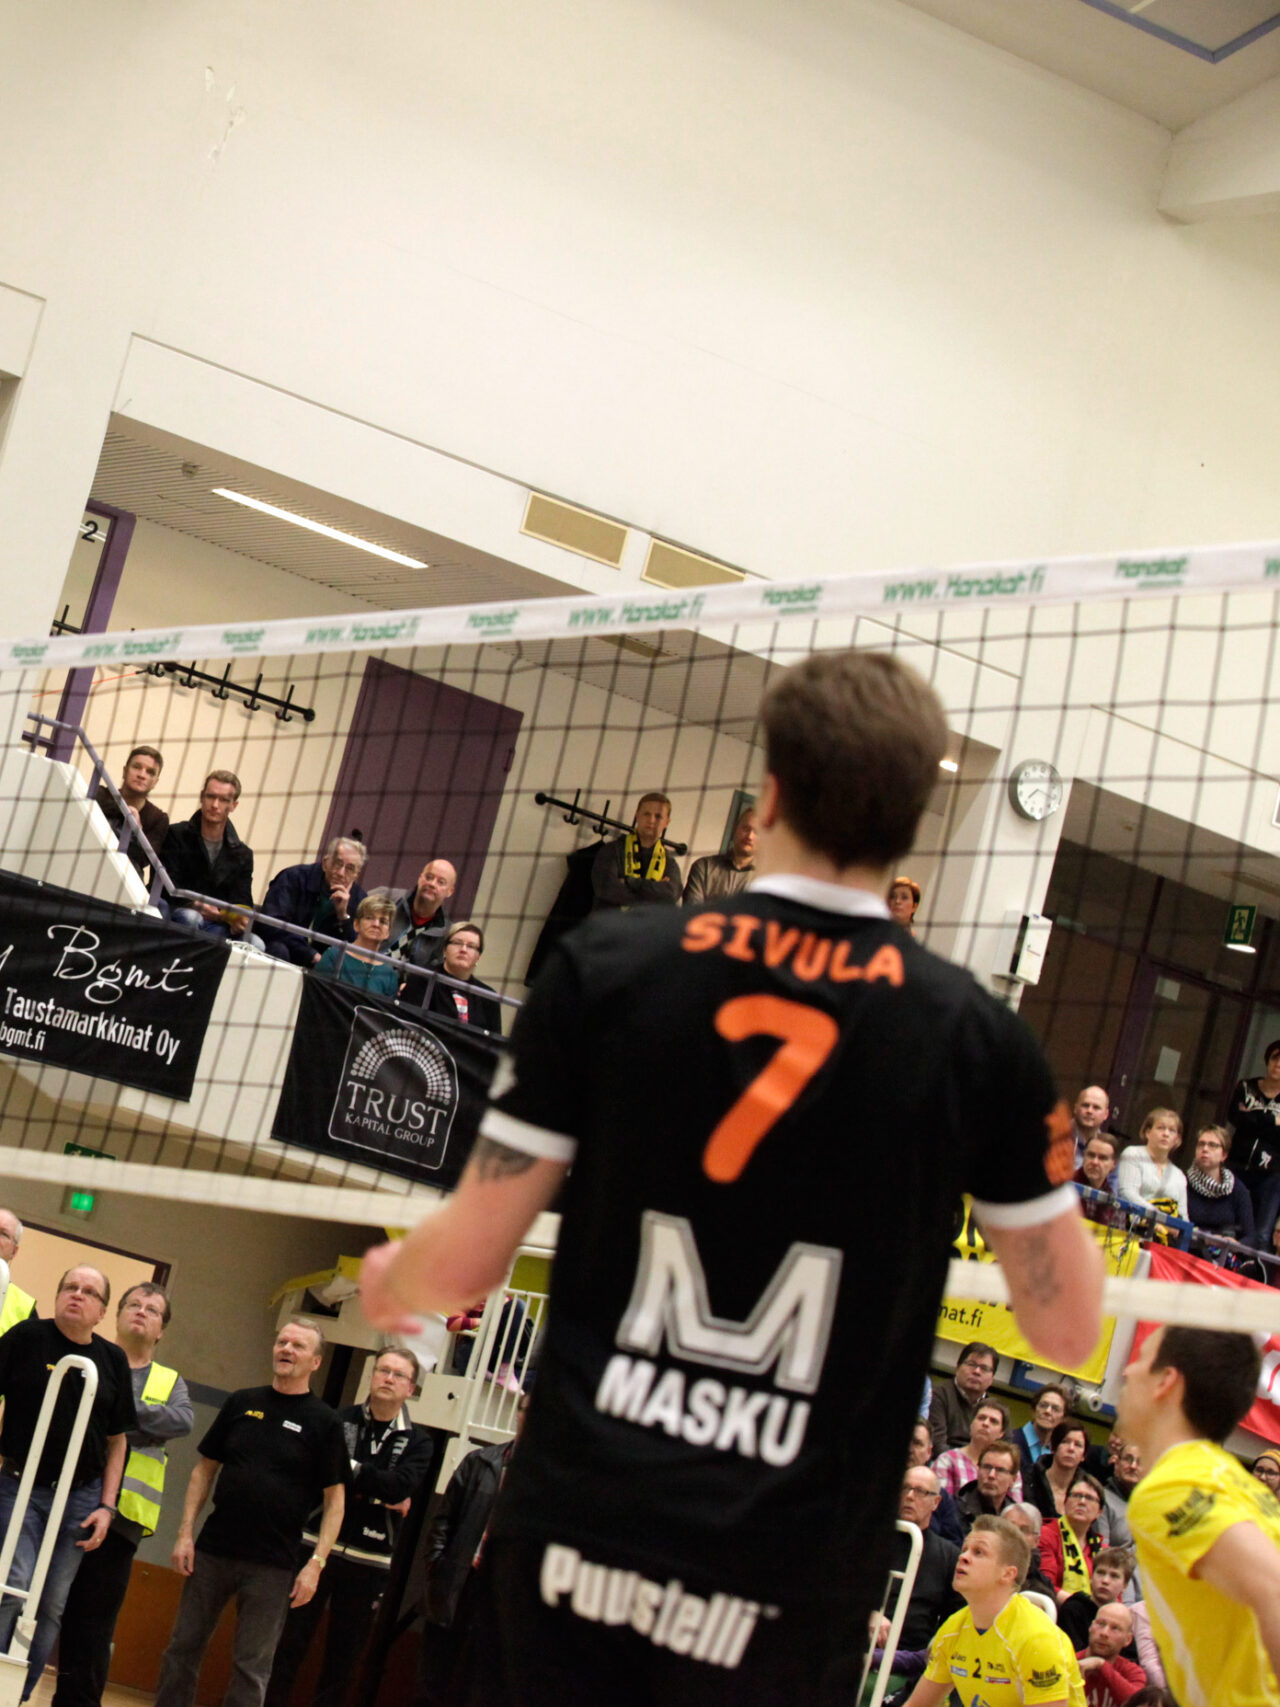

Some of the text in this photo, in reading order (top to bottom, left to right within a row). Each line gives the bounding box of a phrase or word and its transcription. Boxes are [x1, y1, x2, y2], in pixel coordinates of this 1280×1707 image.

[81, 519, 100, 543] 2
[682, 912, 905, 987] SIVULA
[4, 986, 182, 1066] Taustamarkkinat Oy
[346, 1080, 448, 1136] TRUST
[702, 994, 840, 1184] 7
[345, 1112, 436, 1149] KAPITAL GROUP
[595, 1354, 811, 1468] MASKU
[539, 1542, 759, 1670] Puustelli
[972, 1657, 982, 1679] 2
